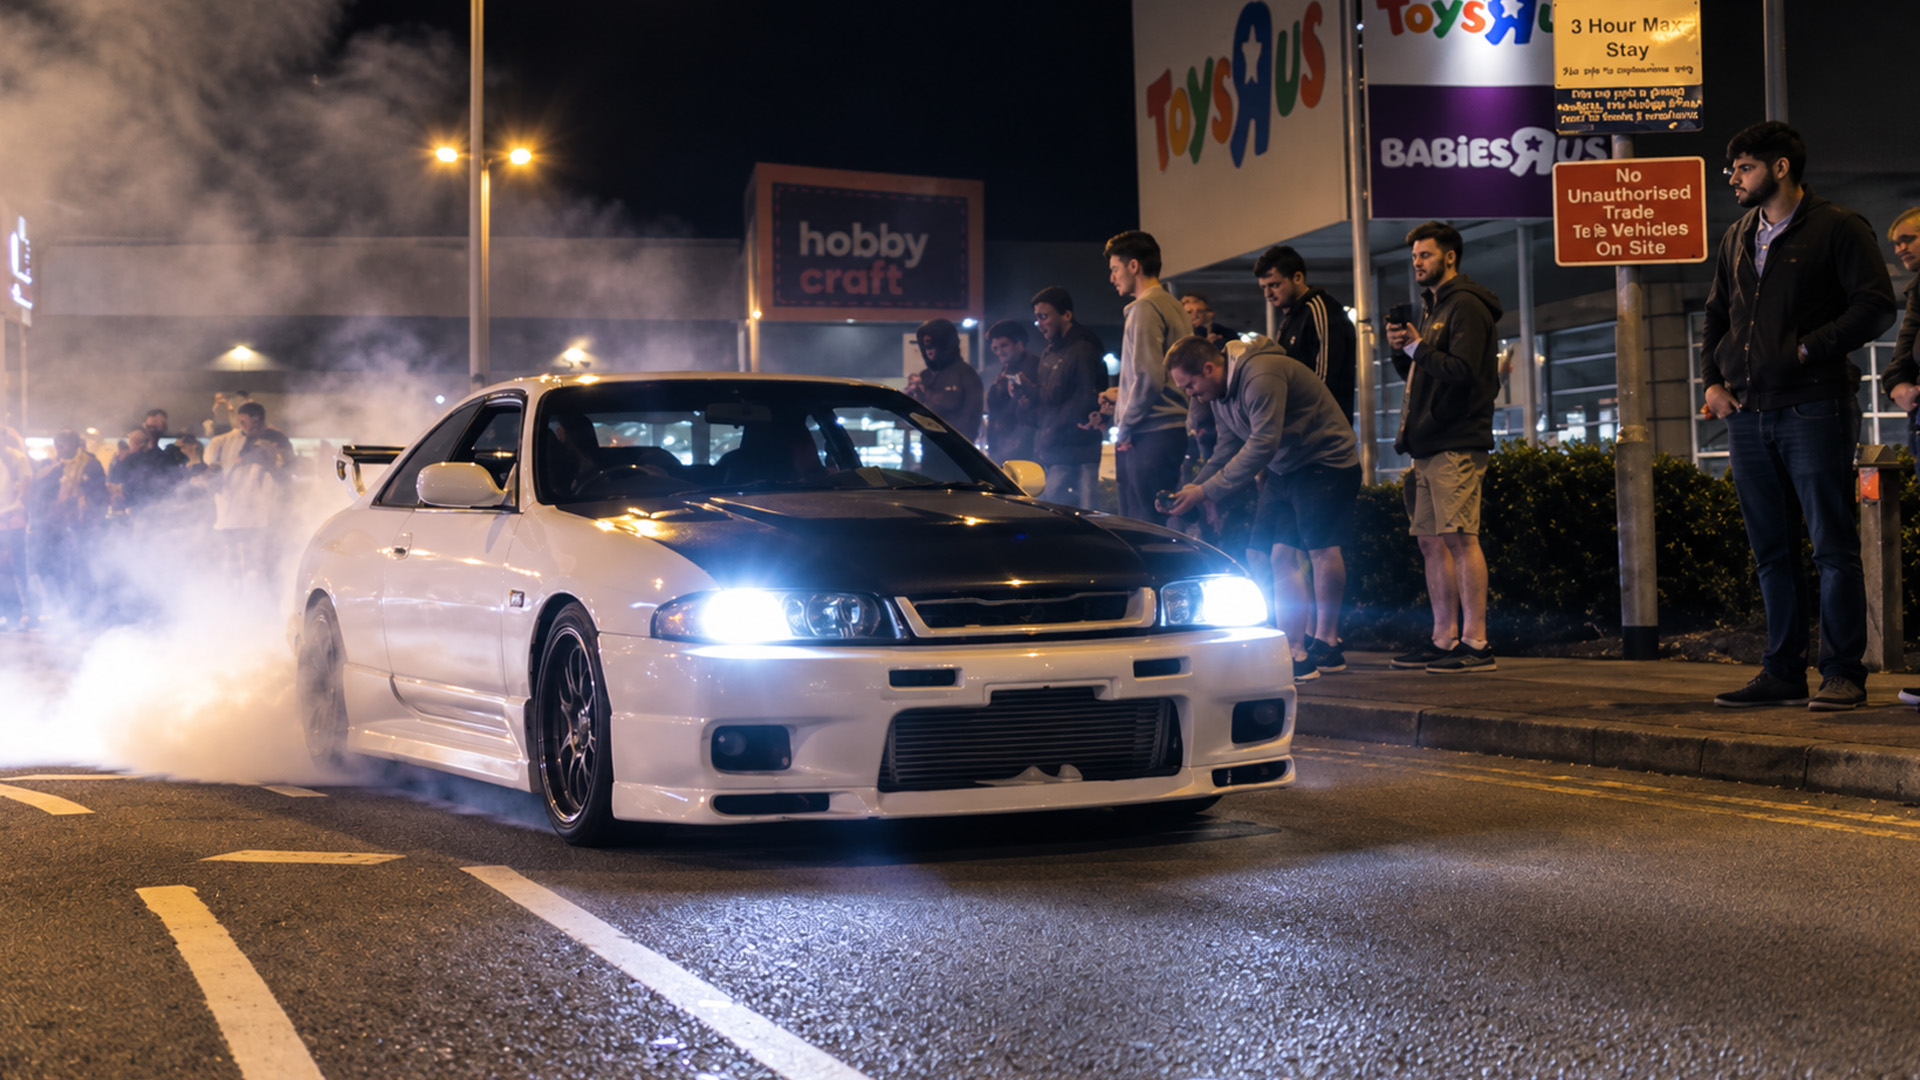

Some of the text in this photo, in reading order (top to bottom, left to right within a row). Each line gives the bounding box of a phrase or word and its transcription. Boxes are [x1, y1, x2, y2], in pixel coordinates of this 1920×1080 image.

[1571, 17, 1682, 34] 3 Hour Max
[1606, 42, 1650, 61] Stay
[1616, 168, 1642, 183] No
[1568, 184, 1691, 203] Unauthorised
[1603, 204, 1654, 219] Trade
[1612, 222, 1689, 237] Vehicles
[800, 221, 929, 268] hobby
[1596, 240, 1666, 256] On Site
[801, 260, 903, 295] craft
